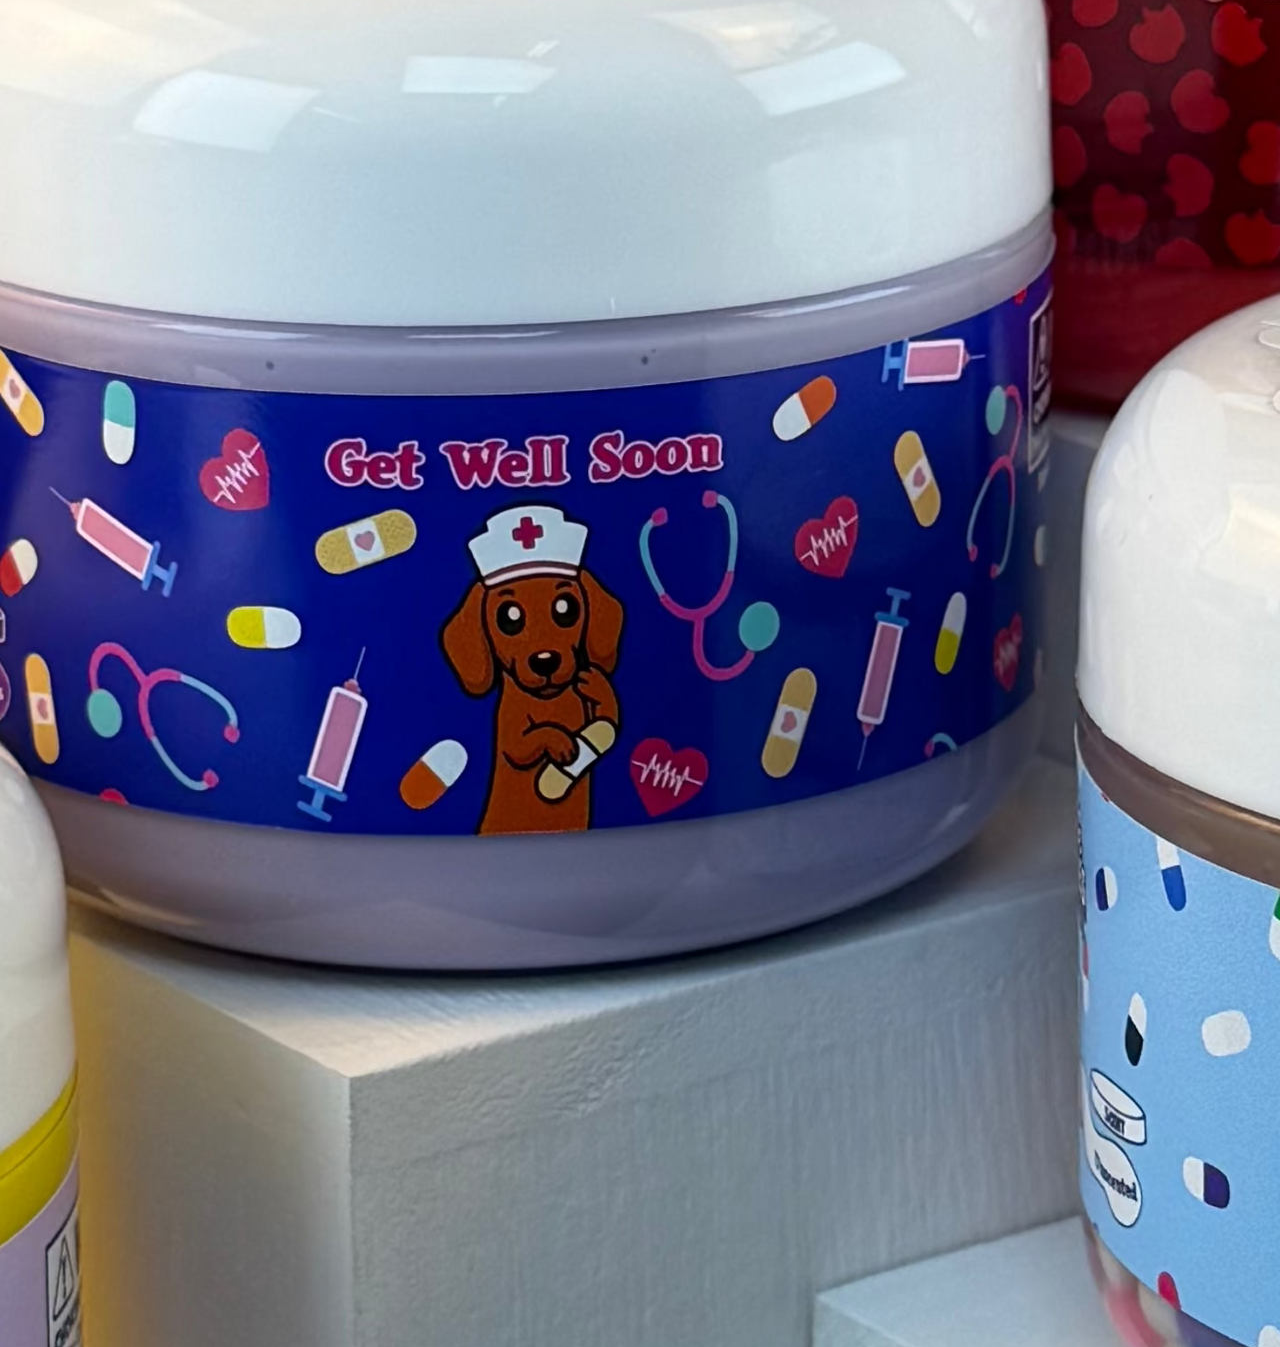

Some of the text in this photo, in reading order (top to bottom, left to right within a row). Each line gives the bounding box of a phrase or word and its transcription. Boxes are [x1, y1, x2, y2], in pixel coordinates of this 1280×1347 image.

[324, 429, 724, 490] Get Well Soon
